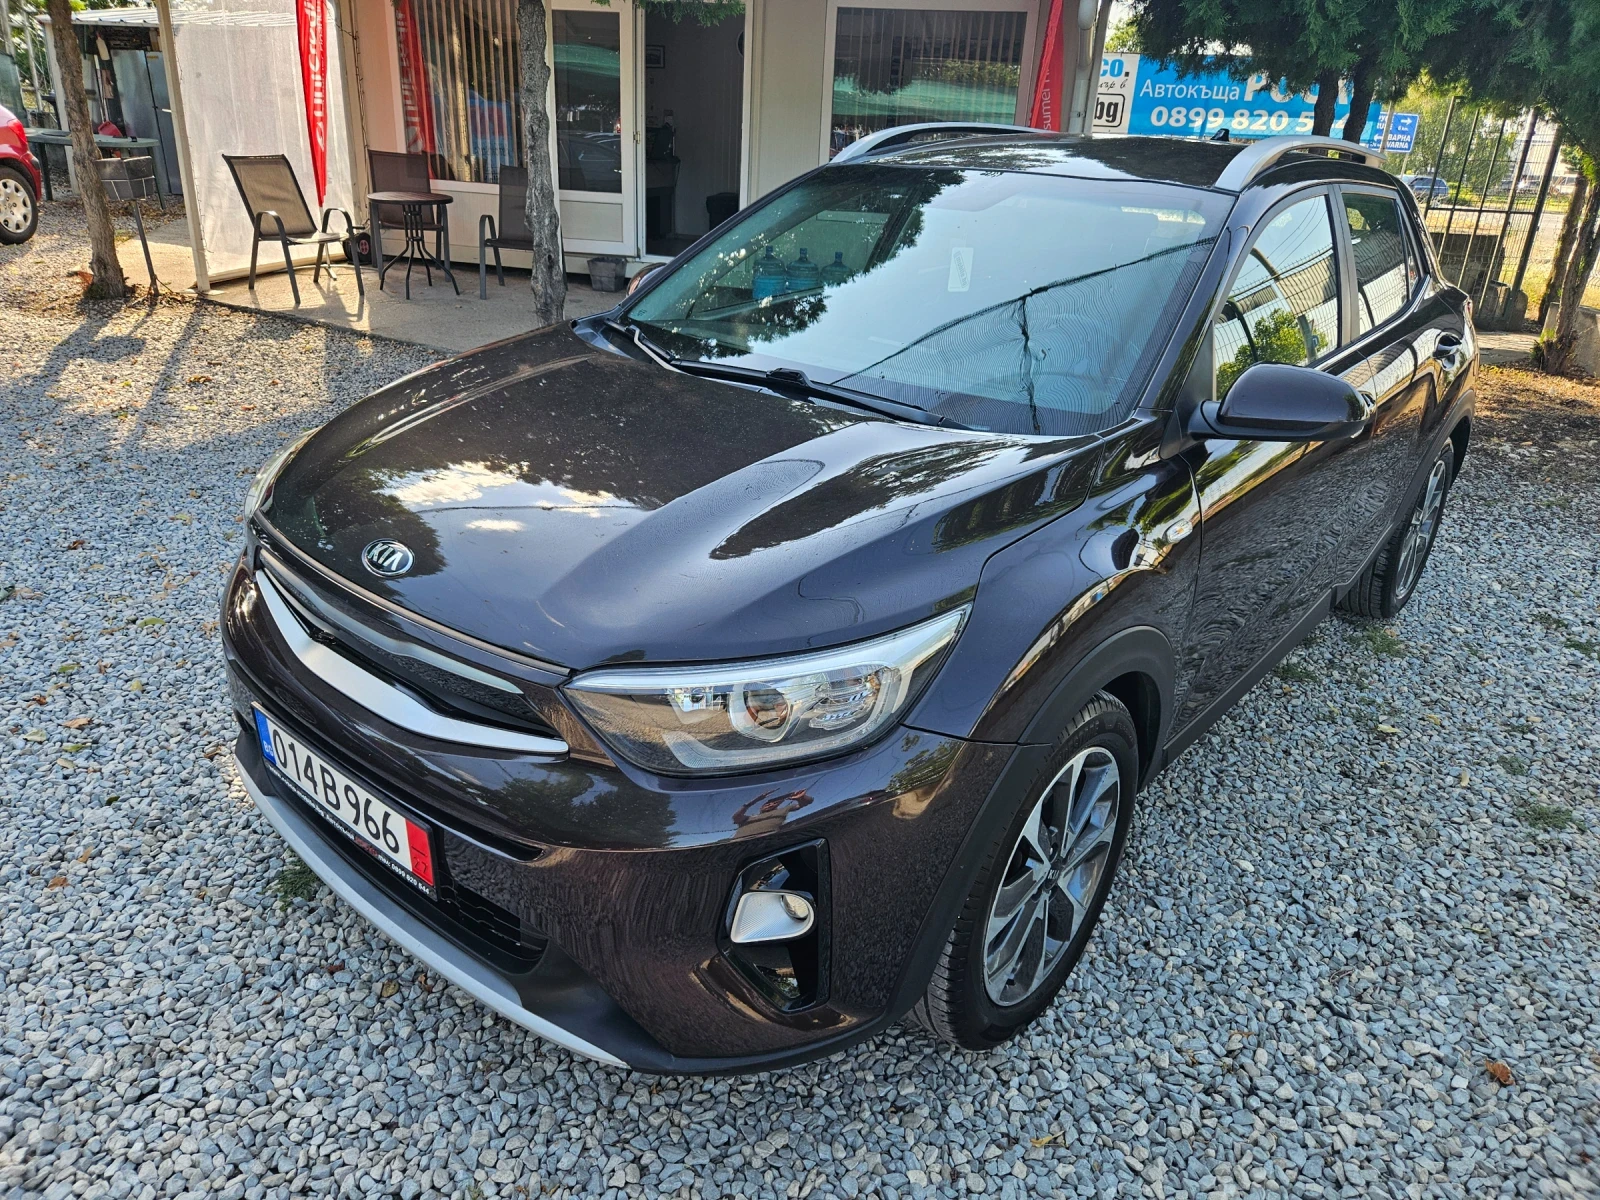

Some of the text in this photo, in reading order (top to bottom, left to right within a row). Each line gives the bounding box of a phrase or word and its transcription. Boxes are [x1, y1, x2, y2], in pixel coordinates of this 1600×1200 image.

[1140, 79, 1240, 103] Автокъща
[1094, 97, 1119, 123] bg
[1150, 105, 1225, 128] 0899
[1231, 109, 1289, 131] 820
[1386, 141, 1409, 149] VARNA
[367, 542, 404, 571] KIA
[272, 728, 399, 854] 014B966
[1047, 869, 1060, 880] KIA
